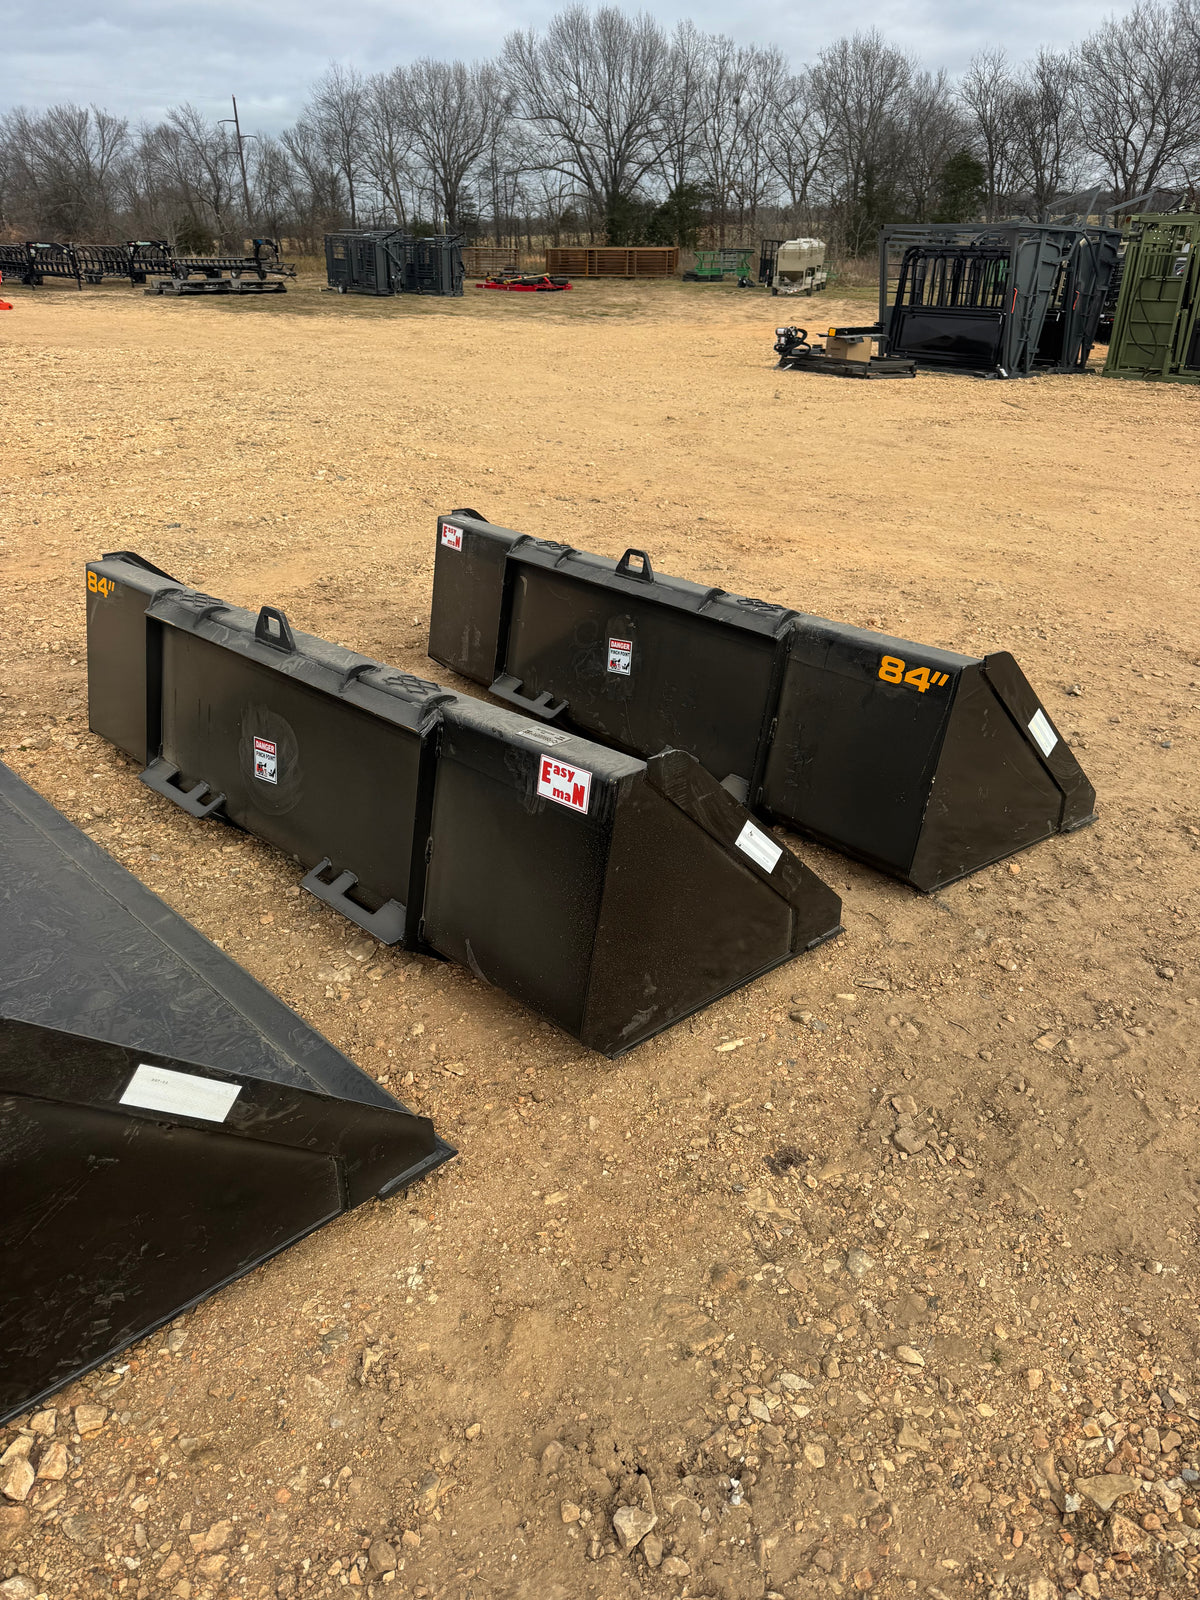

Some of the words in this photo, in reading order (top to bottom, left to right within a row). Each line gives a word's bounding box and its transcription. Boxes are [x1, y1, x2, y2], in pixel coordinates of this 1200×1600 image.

[610, 641, 631, 650] DANGER
[878, 655, 950, 693] 84"
[255, 740, 275, 753] DANGER
[541, 760, 576, 784] Easy
